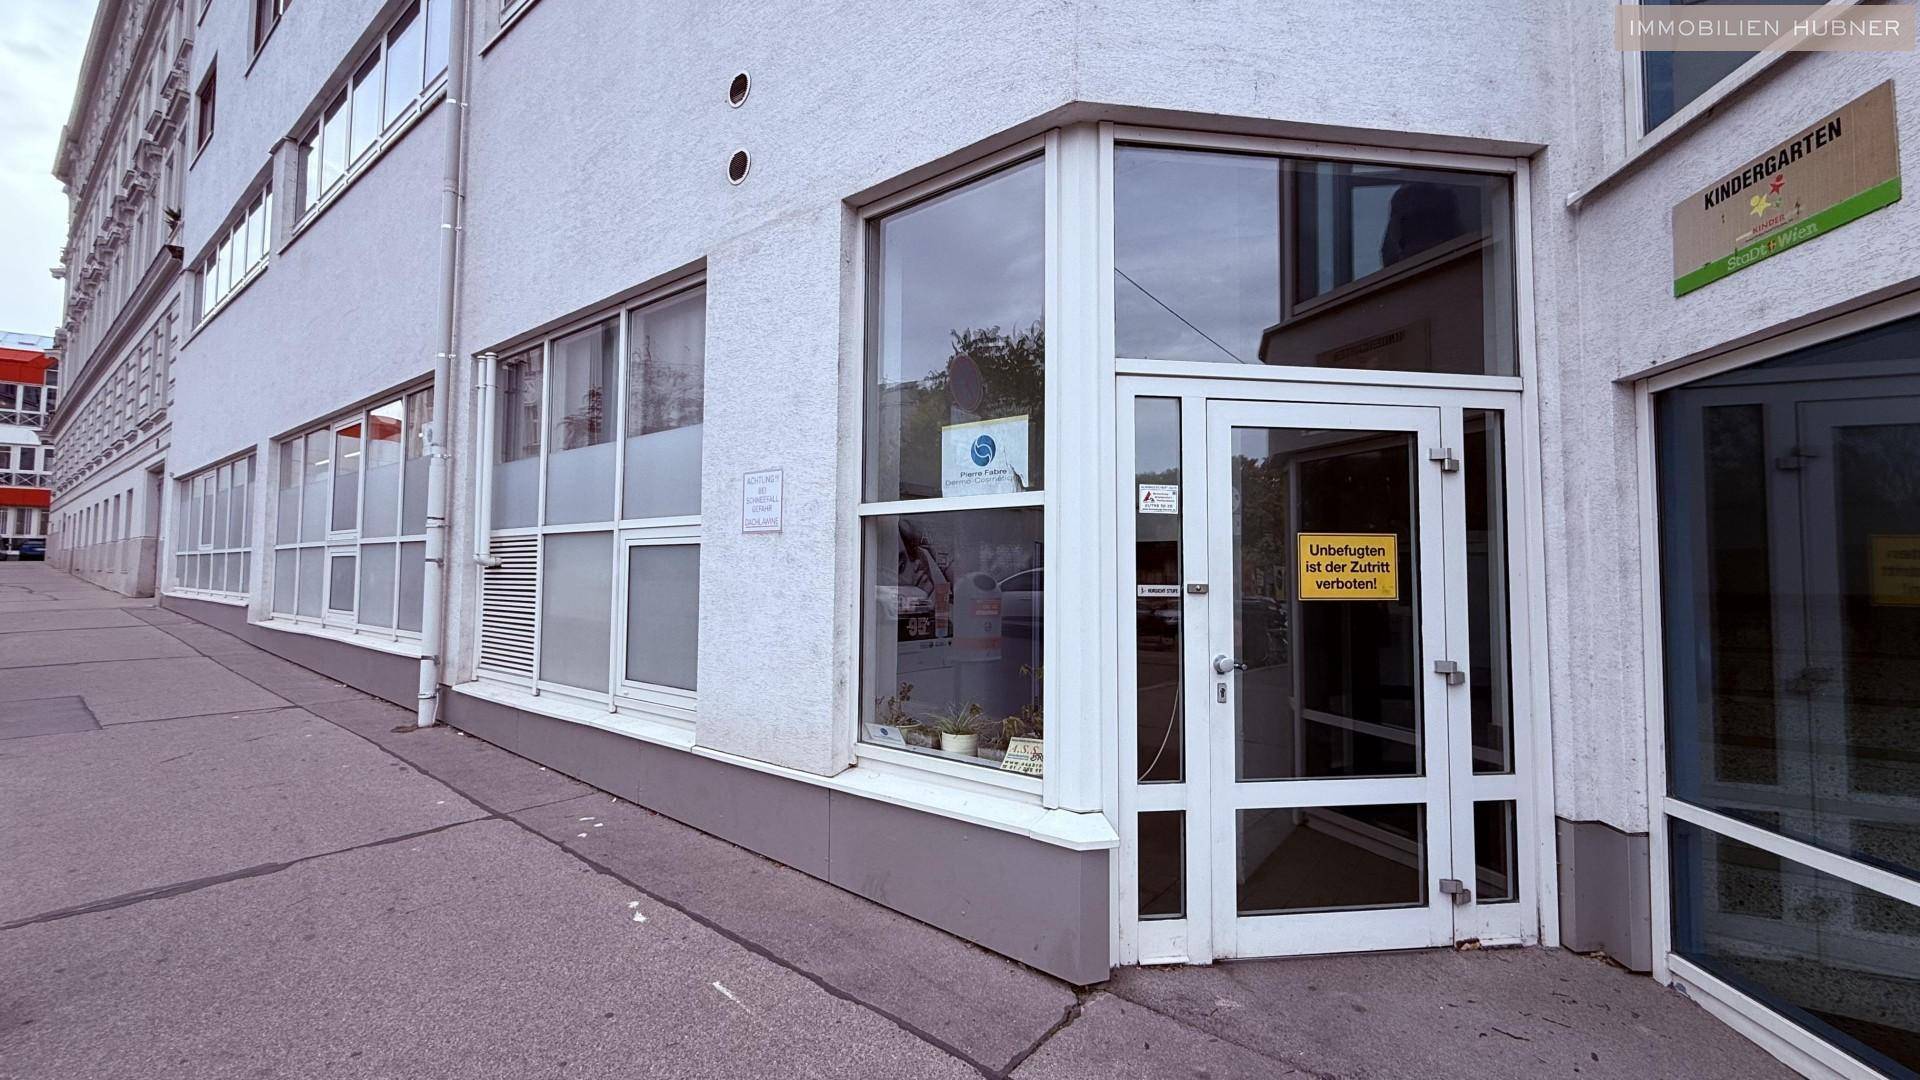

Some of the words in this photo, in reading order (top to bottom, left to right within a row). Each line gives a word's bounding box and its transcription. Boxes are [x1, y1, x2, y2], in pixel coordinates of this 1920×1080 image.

[1704, 117, 1843, 210] KINDERGARTEN
[1752, 213, 1786, 235] KINDER
[1309, 544, 1386, 559] Unbefugten
[1305, 560, 1322, 573] ist
[1325, 561, 1347, 573] der
[1350, 561, 1390, 573] Zutritt
[1315, 578, 1377, 590] verboten!
